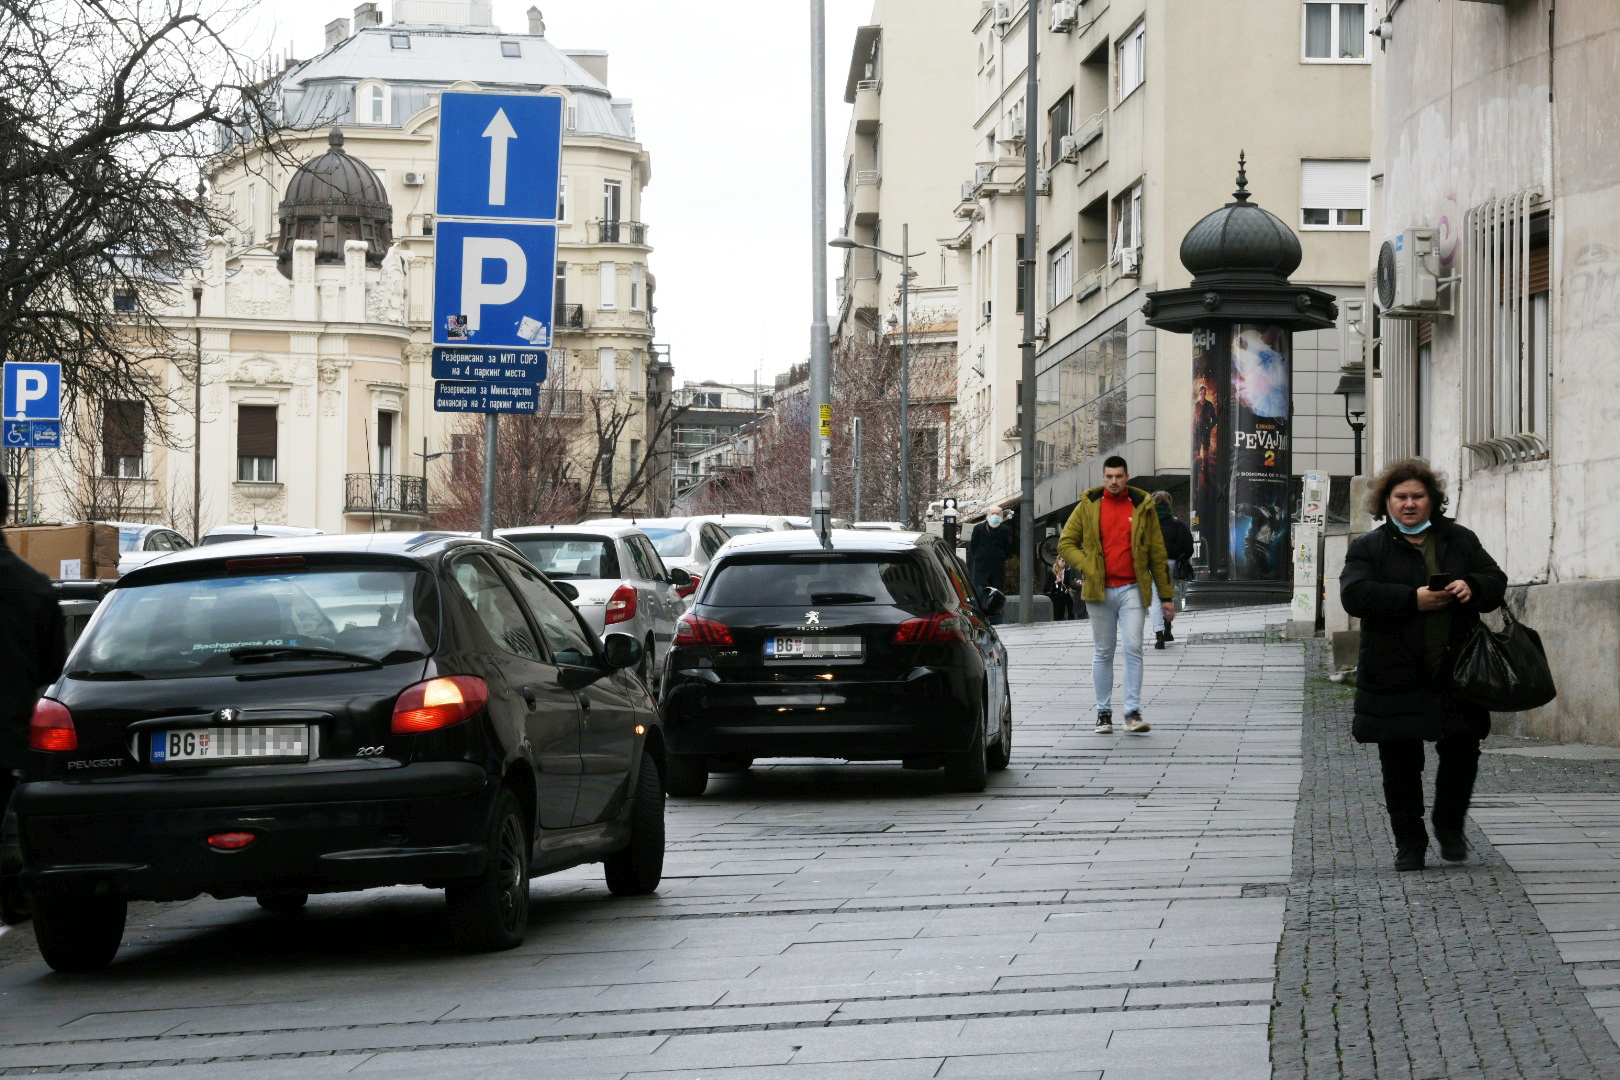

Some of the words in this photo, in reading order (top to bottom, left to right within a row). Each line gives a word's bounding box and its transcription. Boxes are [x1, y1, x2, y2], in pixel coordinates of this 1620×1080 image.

[460, 236, 528, 331] P
[441, 351, 484, 365] Резервисано
[488, 355, 496, 363] за
[500, 353, 516, 364] МУП
[452, 367, 460, 376] на
[464, 365, 470, 376] 4
[474, 369, 501, 378] паркинг
[505, 369, 526, 378] места
[16, 369, 48, 412] P
[440, 384, 477, 396] Резервисано
[490, 385, 532, 398] Министарство
[470, 399, 479, 408] на
[481, 398, 487, 408] 2
[489, 401, 513, 410] паркинг
[515, 401, 534, 410] места
[1264, 450, 1276, 466] 2
[776, 638, 793, 653] BG
[169, 732, 196, 758] BG
[356, 745, 385, 757] 206
[67, 758, 124, 770] PEUGEOT
